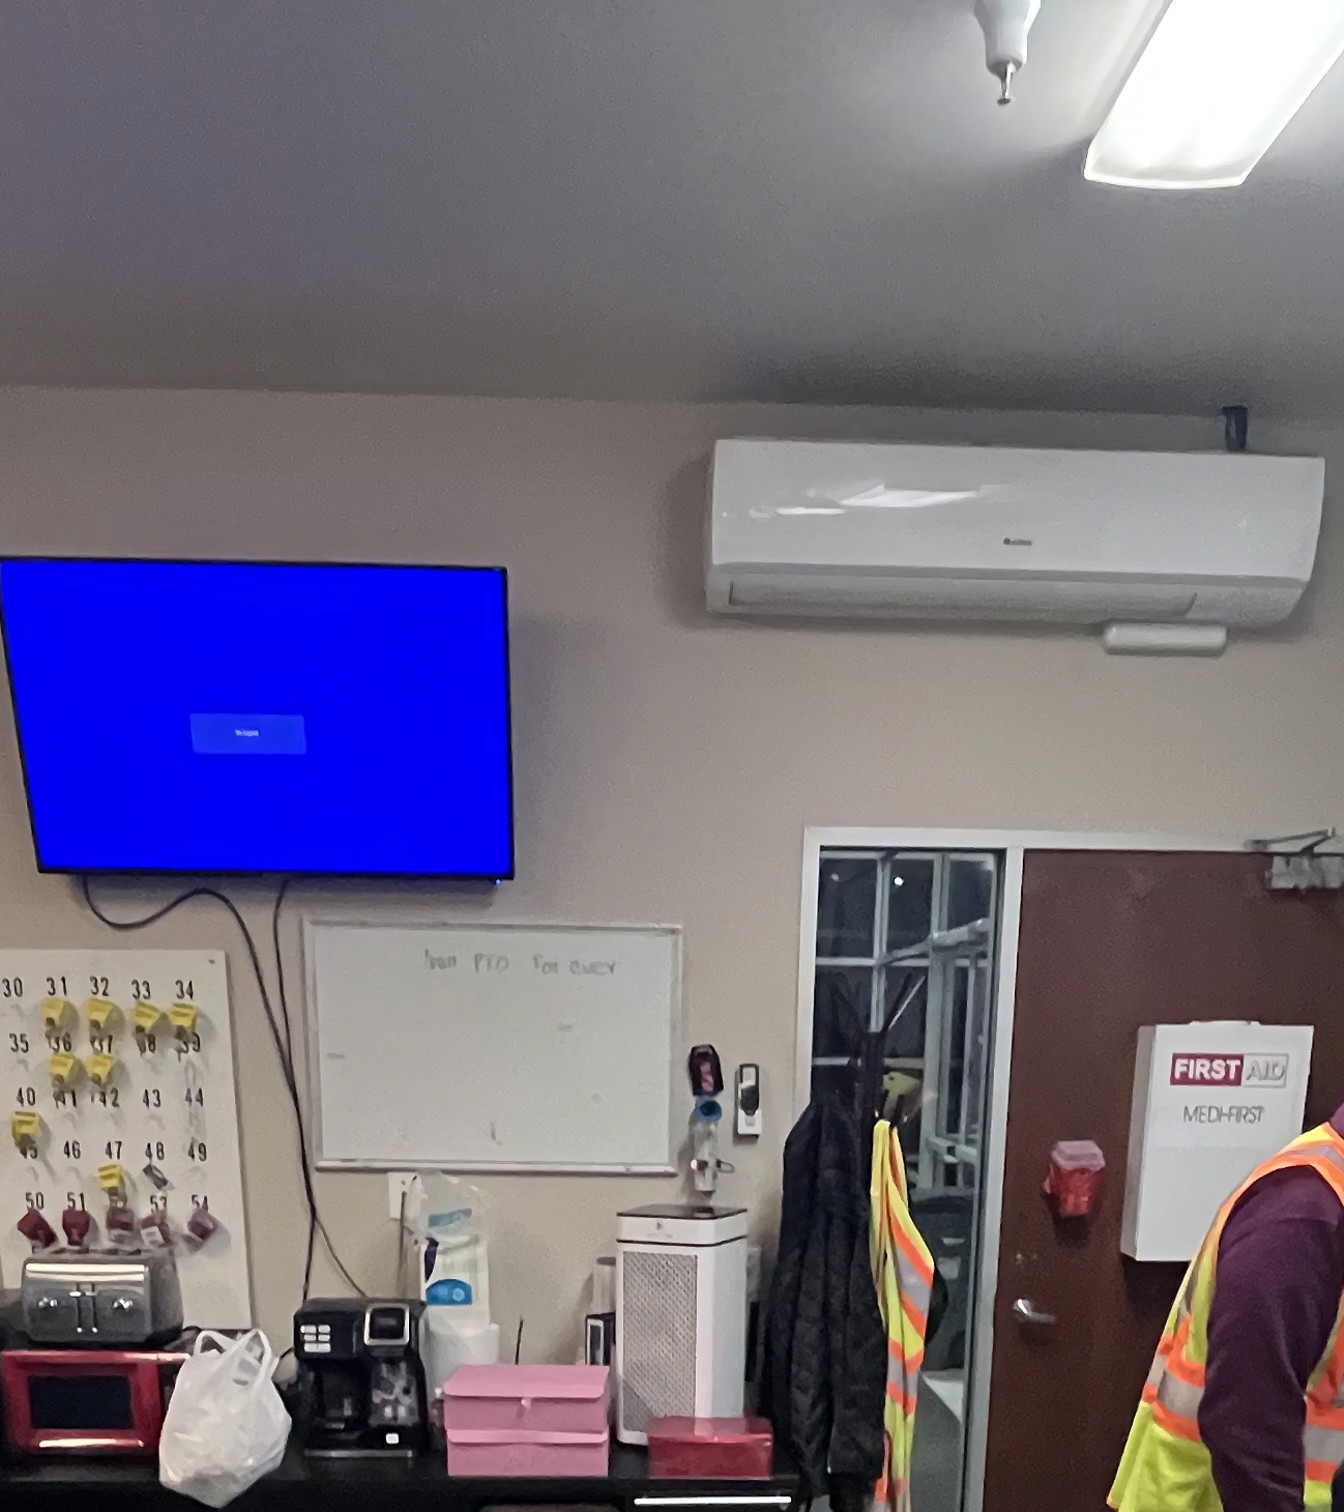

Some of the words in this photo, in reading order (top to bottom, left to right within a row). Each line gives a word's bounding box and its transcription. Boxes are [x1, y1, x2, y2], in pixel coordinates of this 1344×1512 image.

[2, 977, 23, 998] 30
[46, 976, 68, 997] 31
[90, 975, 110, 997] 32
[131, 979, 151, 1000] 33
[175, 979, 194, 1000] 34
[9, 1033, 29, 1053] 35
[1174, 1059, 1241, 1080] FIRST
[1246, 1060, 1286, 1081] AID
[16, 1087, 36, 1107] 40
[100, 1087, 120, 1108] 42
[142, 1089, 161, 1109] 43
[185, 1087, 205, 1107] 44
[64, 1140, 81, 1160] 46
[105, 1140, 123, 1160] 47
[145, 1141, 165, 1161] 48
[188, 1142, 207, 1162] 49
[26, 1191, 44, 1210] 50
[67, 1192, 85, 1212] 51
